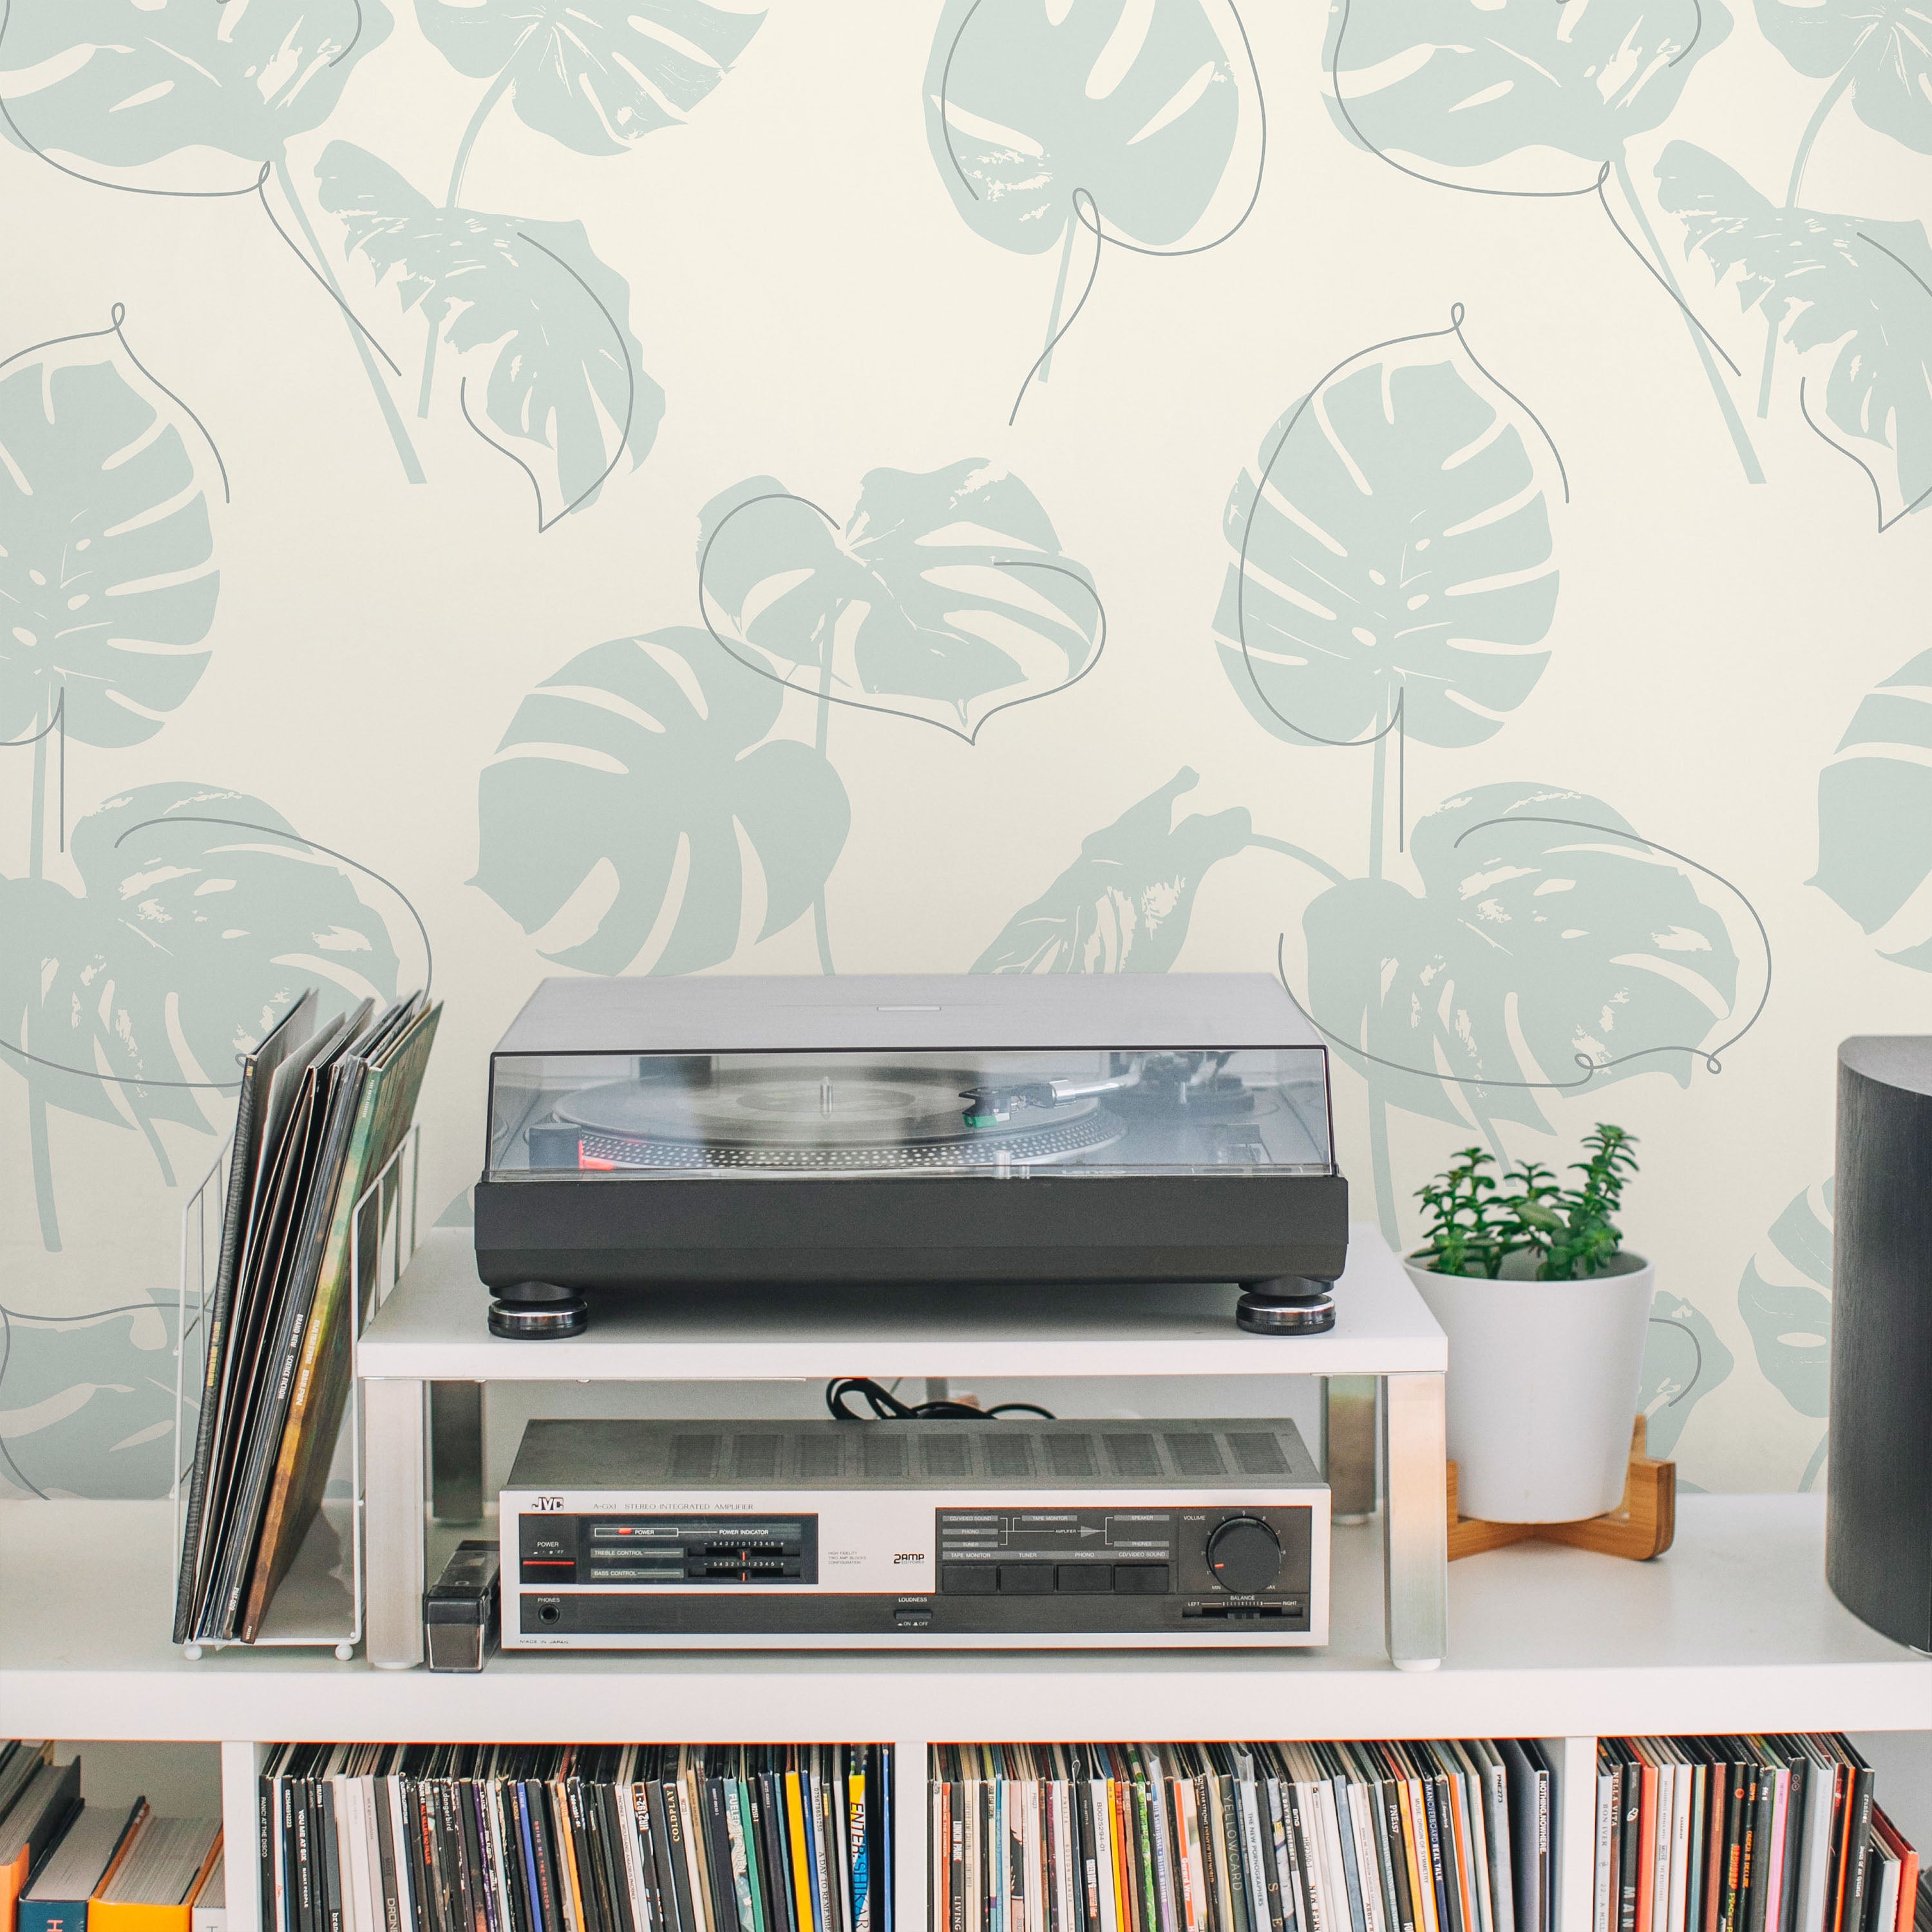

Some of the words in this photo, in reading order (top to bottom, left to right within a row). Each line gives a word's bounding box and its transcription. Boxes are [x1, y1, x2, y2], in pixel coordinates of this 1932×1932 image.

[292, 1314, 304, 1332] BRAND
[289, 1332, 298, 1349] NEW
[281, 1354, 294, 1379] SCIENCE
[277, 1377, 288, 1401] FICTION
[531, 1497, 564, 1510] JVC
[442, 1793, 453, 1832] dangerbird
[635, 1793, 650, 1832] HR2192-1
[667, 1790, 680, 1842] COLDPLAY
[728, 1794, 740, 1825] FUELED
[1284, 1815, 1291, 1824] TO
[1389, 1804, 1399, 1834] PNE157
[1425, 1784, 1439, 1842] MANOVERBOARD
[299, 1826, 305, 1838] ME
[953, 1821, 962, 1842] LINKIN
[1097, 1802, 1105, 1852] B0025294-01
[300, 1839, 306, 1848] AT
[953, 1843, 962, 1861] PARK
[1223, 1794, 1242, 1891] YELLOWCARD
[1286, 1826, 1296, 1862] REMEMBER
[1303, 1837, 1312, 1868] HR2350-1
[1180, 1857, 1190, 1882] Gerard
[1251, 1845, 1264, 1907] PORNOGRAPHERS
[1421, 1850, 1429, 1884] SYMMETRY
[820, 1878, 828, 1889] TO
[1183, 1884, 1191, 1902] Way
